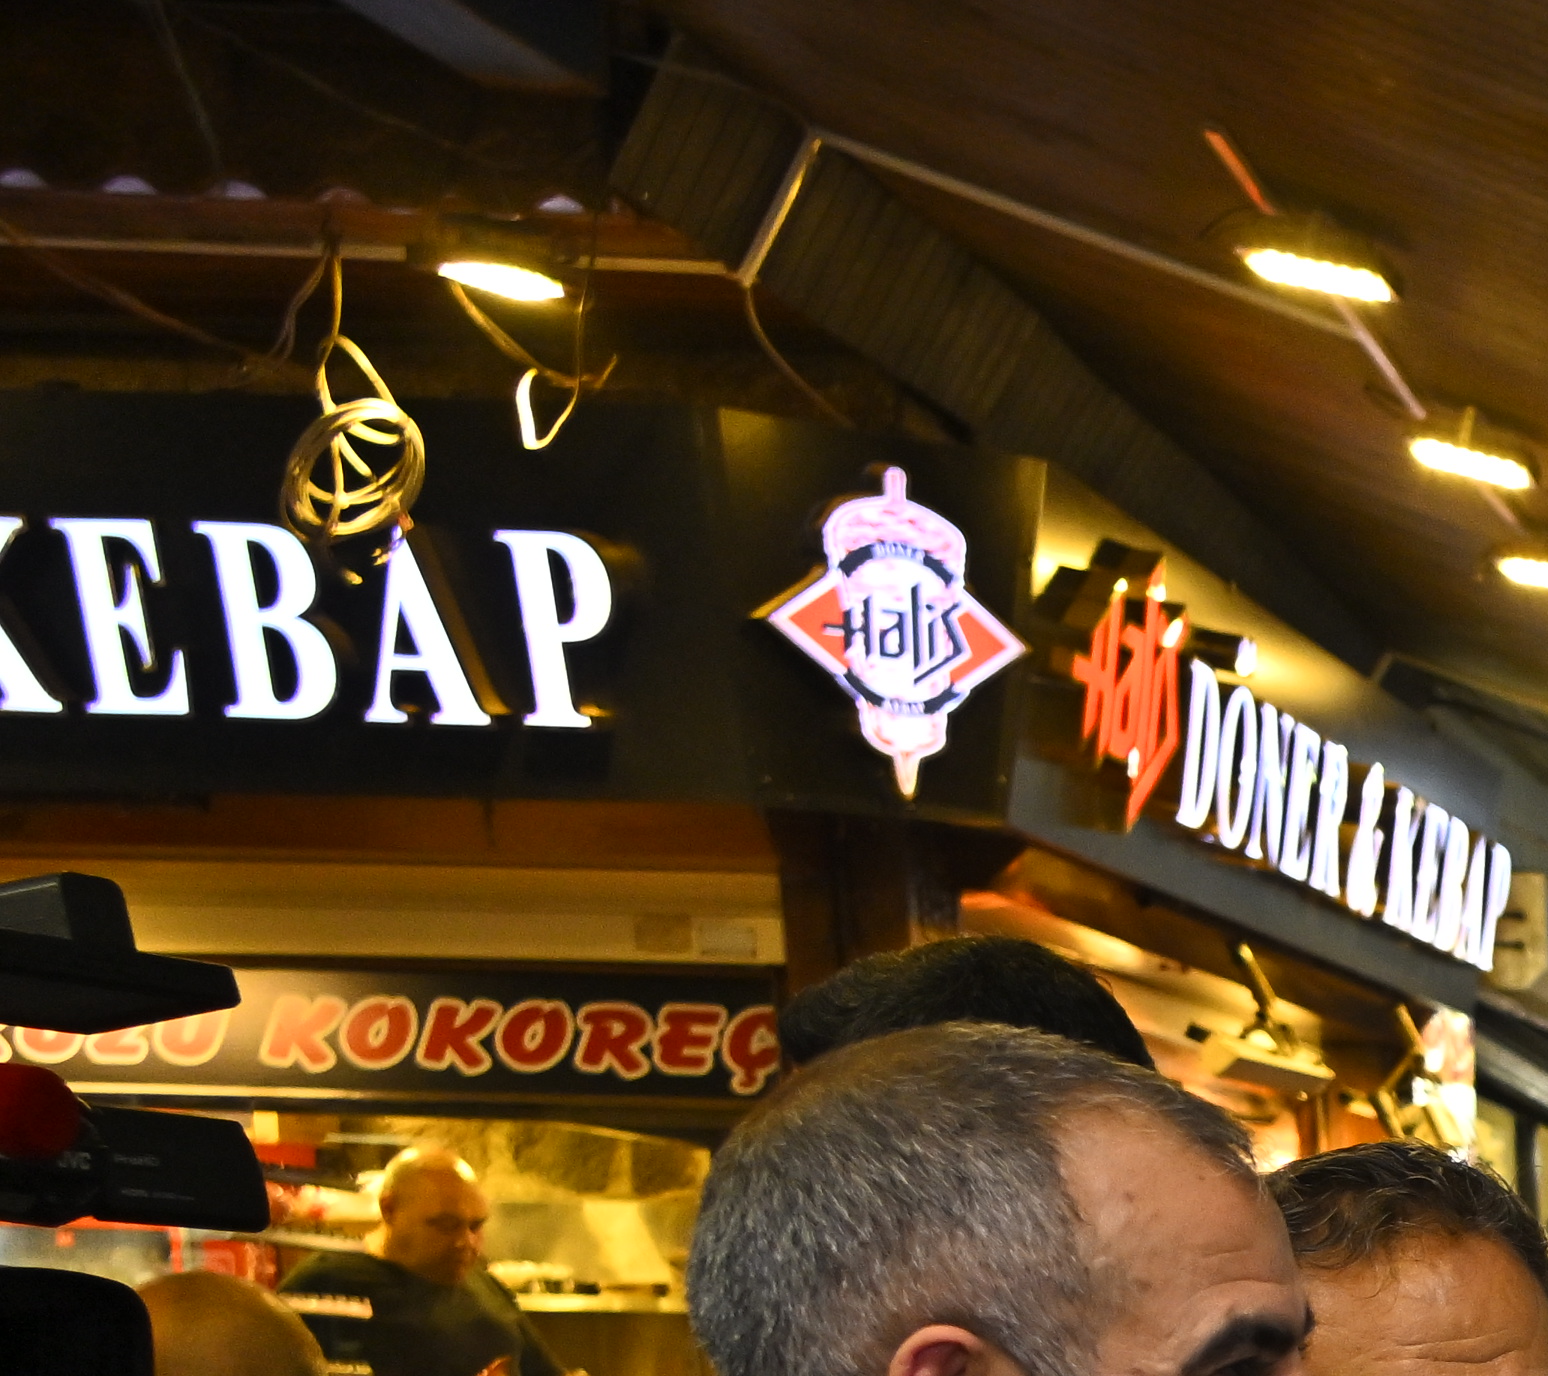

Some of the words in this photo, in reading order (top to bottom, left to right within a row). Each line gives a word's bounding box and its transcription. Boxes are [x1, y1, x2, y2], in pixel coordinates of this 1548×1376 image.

[1346, 762, 1385, 918] &
[1383, 786, 1513, 972] KEBAP
[258, 993, 778, 1096] KOKOREÇ
